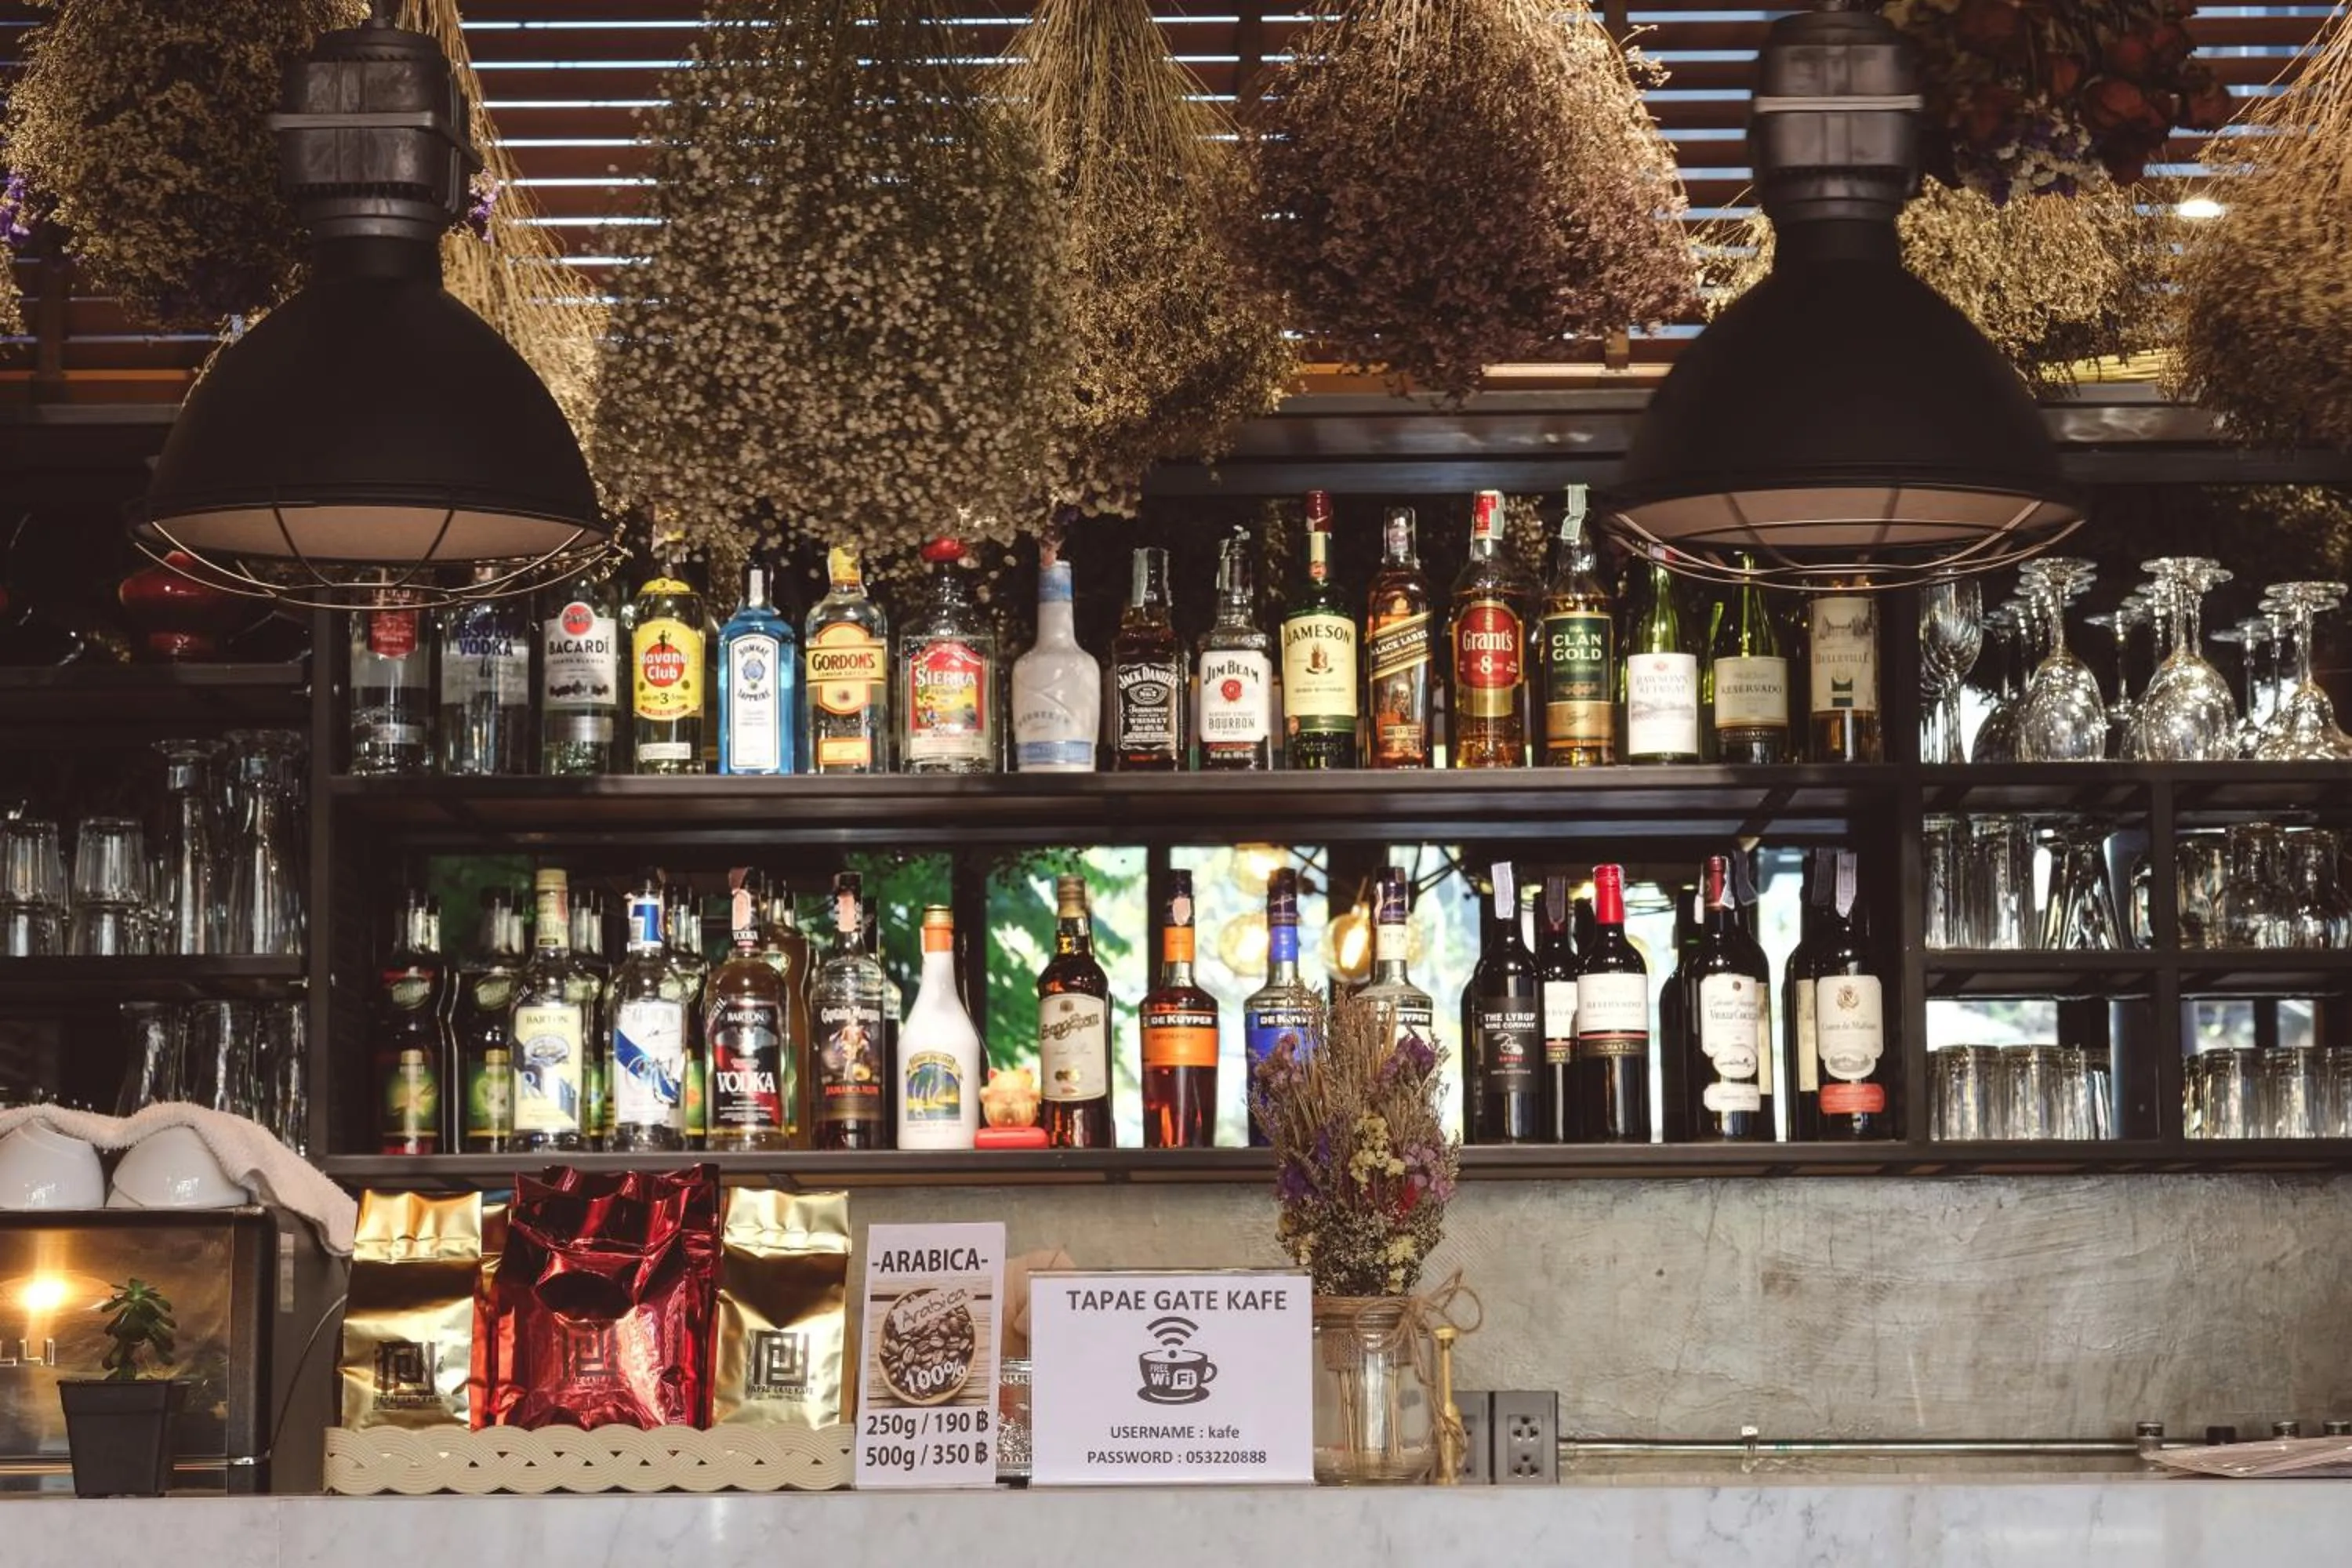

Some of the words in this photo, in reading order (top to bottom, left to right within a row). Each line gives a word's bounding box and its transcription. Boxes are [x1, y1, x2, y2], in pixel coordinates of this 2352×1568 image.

[1286, 624, 1350, 647] JAMESON
[1463, 630, 1513, 652] Grant's
[1552, 634, 1602, 646] CLAN
[459, 639, 514, 656] VODKA
[1552, 648, 1602, 661] GOLD
[640, 652, 689, 665] Havana
[812, 652, 875, 671] GORDON'S
[1480, 655, 1493, 674] 8
[648, 666, 678, 680] Club
[916, 668, 977, 688] SIERRA
[1119, 671, 1142, 689] JACK
[1204, 664, 1225, 684] JIM
[1228, 659, 1259, 684] BEAM
[660, 692, 669, 704] 3
[1208, 717, 1255, 729] BOURBON
[1151, 1016, 1165, 1025] DE
[1167, 1014, 1212, 1025] KUYPER
[1260, 1016, 1275, 1025] DE
[1485, 1013, 1502, 1022] THE
[717, 1072, 775, 1093] VODKA
[902, 1288, 967, 1328] Arabica
[1066, 1290, 1146, 1310] TAPAE
[1154, 1290, 1218, 1310] GATE
[1227, 1290, 1287, 1310] KAFE
[905, 1358, 966, 1393] 100%
[1149, 1363, 1168, 1372] FREE
[866, 1415, 916, 1439] 250g
[935, 1412, 970, 1433] 190
[1110, 1426, 1195, 1439] USERNAME
[1208, 1425, 1240, 1439] kafe
[866, 1446, 915, 1471] 500g
[933, 1444, 969, 1465] 350
[1087, 1451, 1173, 1464] PASSWORD
[1186, 1450, 1267, 1464] 053220888
